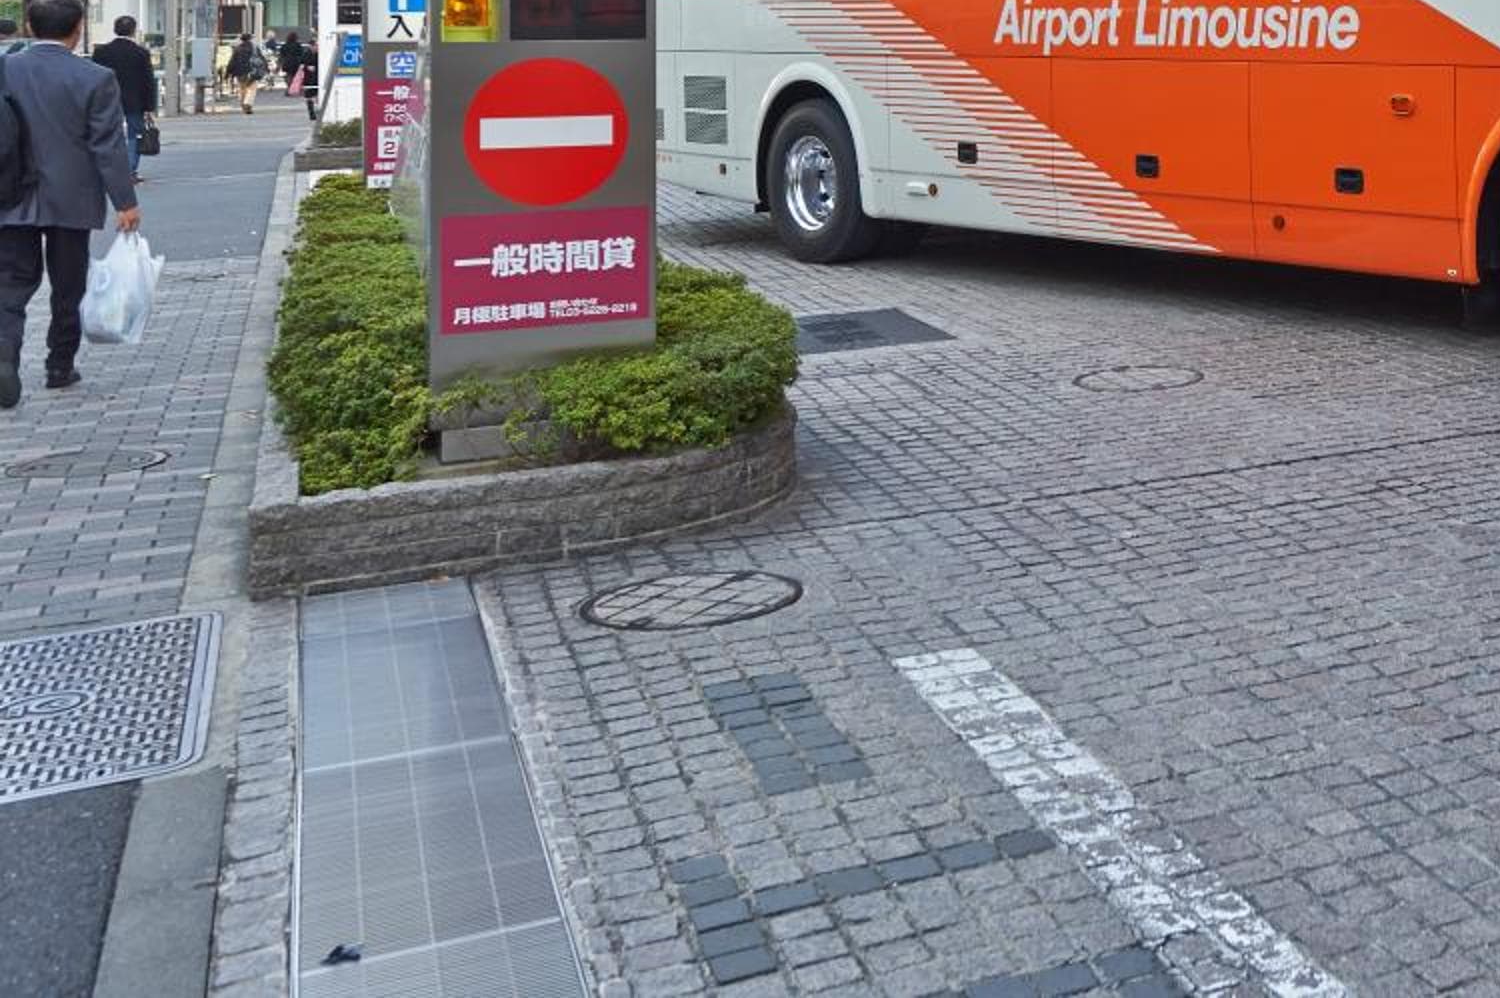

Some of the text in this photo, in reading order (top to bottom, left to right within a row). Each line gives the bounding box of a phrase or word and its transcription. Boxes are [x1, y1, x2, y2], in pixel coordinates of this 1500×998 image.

[387, 15, 425, 38] 入
[390, 53, 416, 75] 空
[453, 236, 636, 277] 一般時間貸
[453, 302, 545, 326] 月極駐車場
